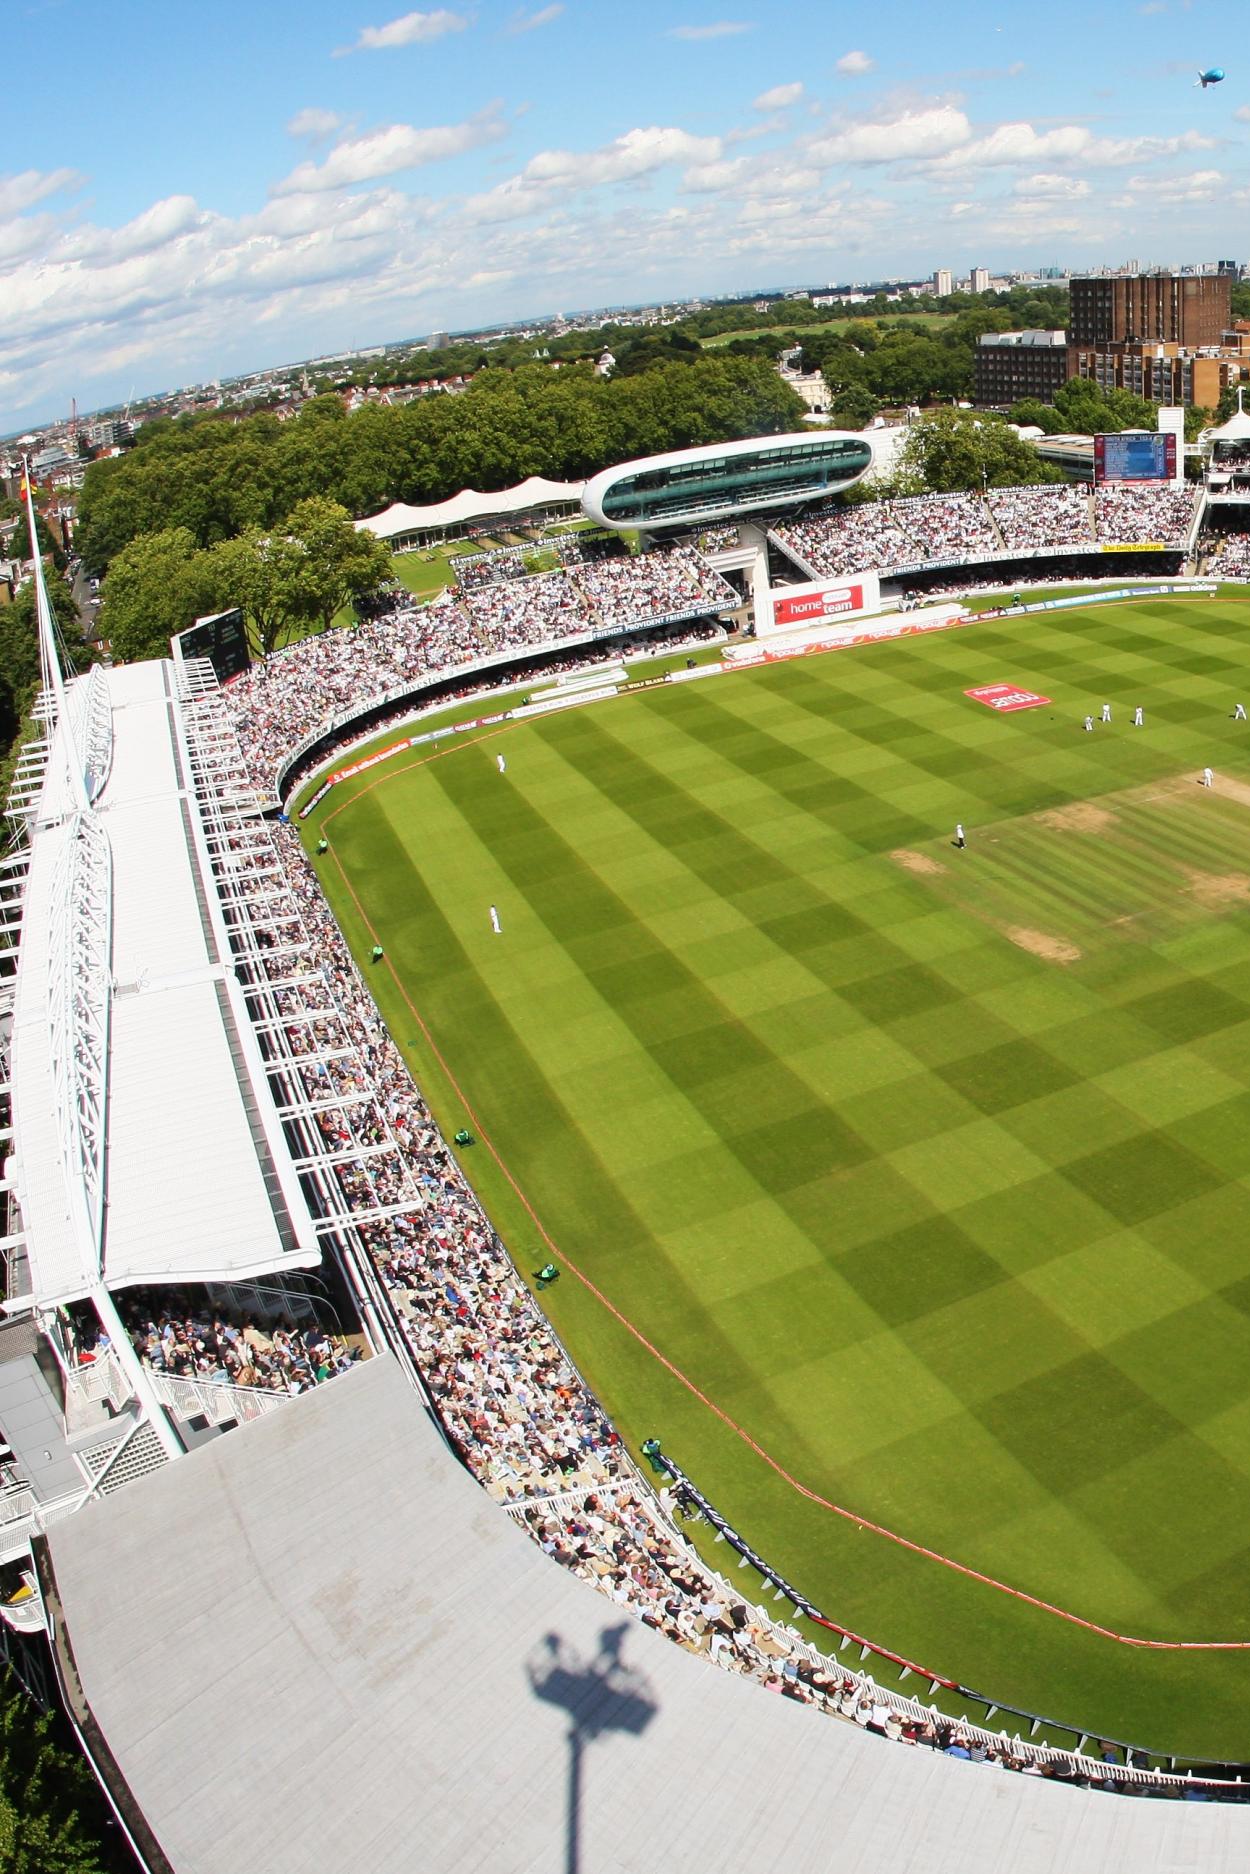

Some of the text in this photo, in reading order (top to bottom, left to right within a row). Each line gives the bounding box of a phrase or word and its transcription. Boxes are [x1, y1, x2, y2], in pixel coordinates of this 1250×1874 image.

[993, 485, 1025, 494] Investec
[1039, 482, 1070, 491] Investec
[935, 490, 965, 500] Investec
[697, 522, 729, 533] Investec
[543, 532, 577, 545] Investec
[501, 542, 535, 553] Investec
[983, 552, 1027, 563] Investec
[894, 559, 961, 575] FRIENDS PROVIDENT
[665, 601, 736, 624] FRIENDS PROVIDENT
[790, 600, 822, 614] home
[824, 600, 852, 614] team
[593, 616, 664, 640] FRIENDS PROVIDENT
[401, 674, 444, 695] Investec
[645, 677, 664, 686] BLASS
[344, 700, 380, 722] Investec
[660, 1455, 730, 1527] Investec
[736, 1541, 811, 1606] Investec
